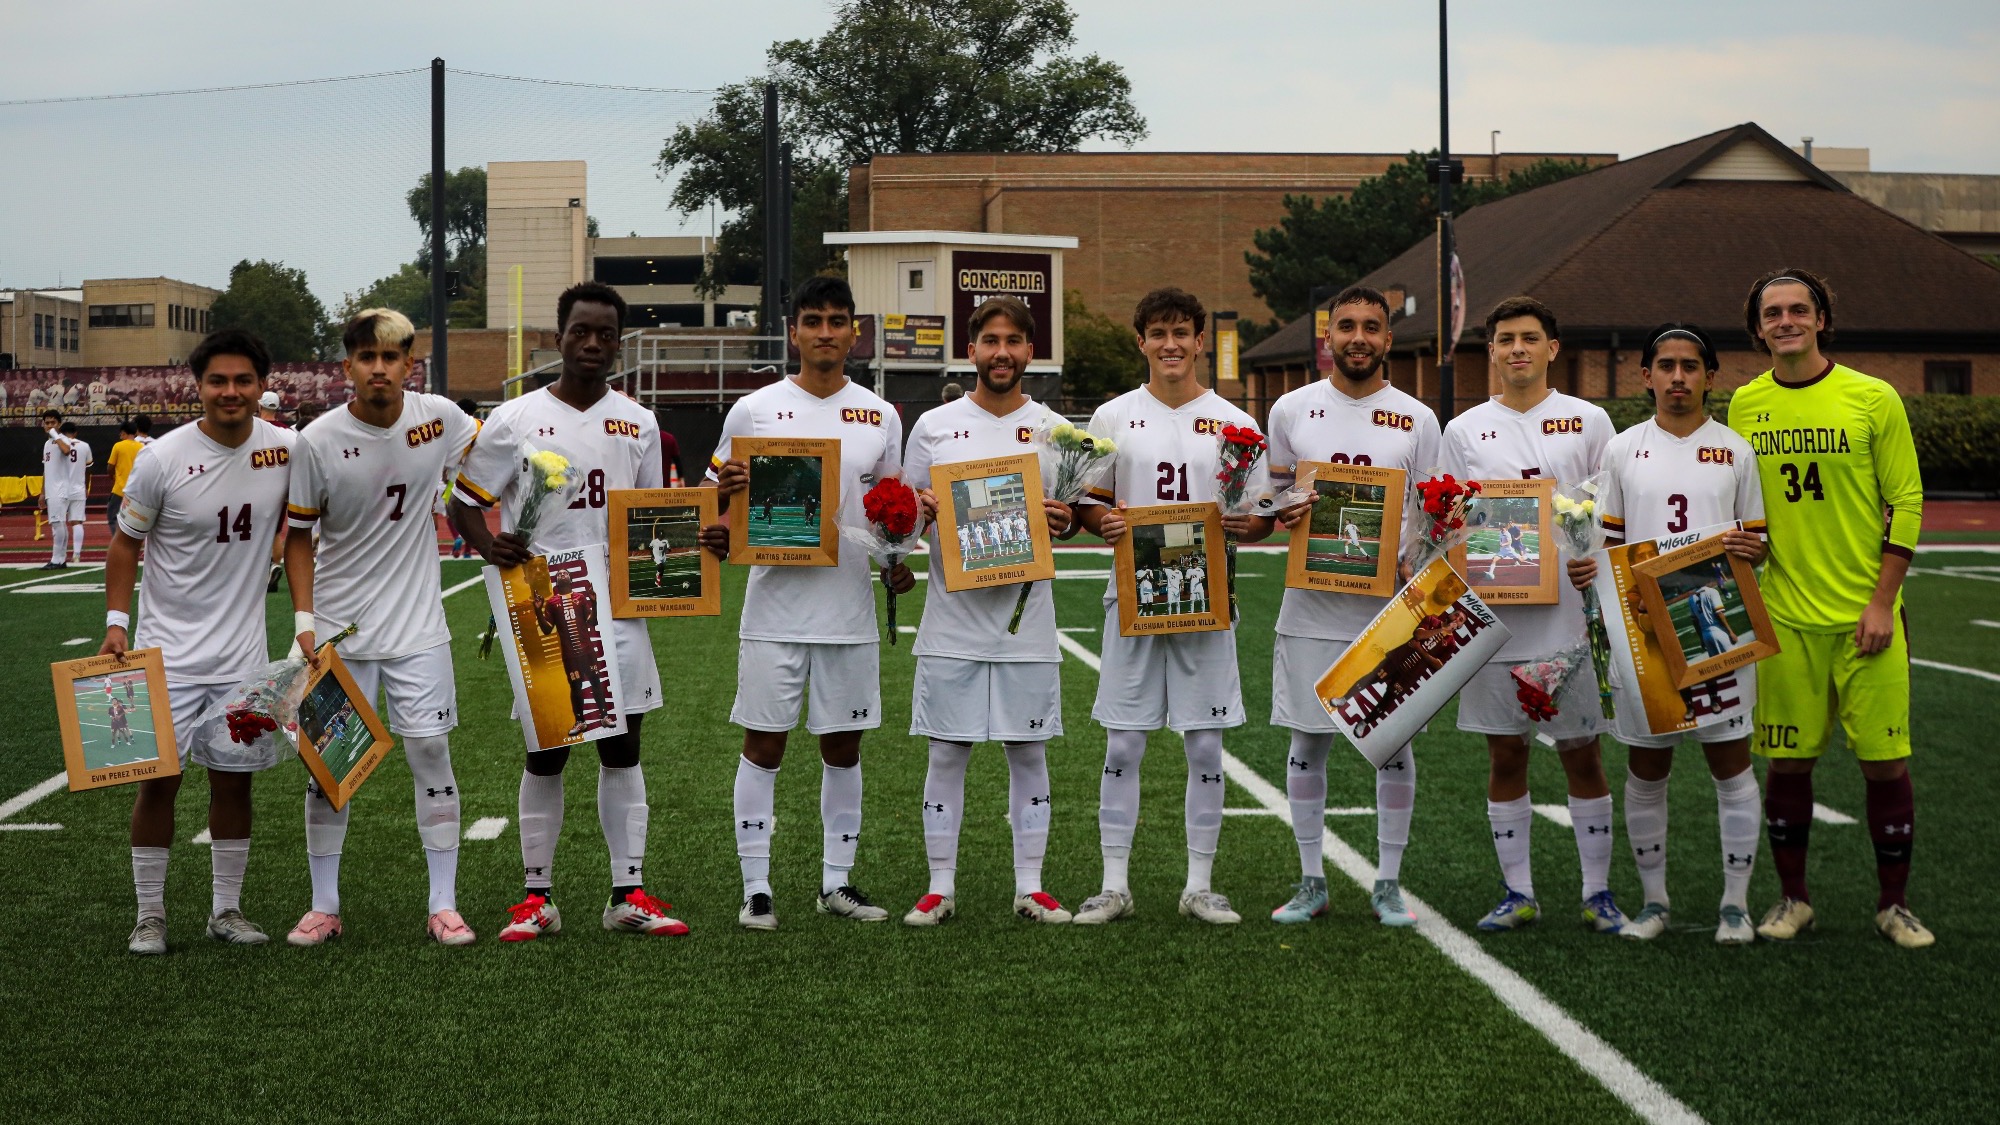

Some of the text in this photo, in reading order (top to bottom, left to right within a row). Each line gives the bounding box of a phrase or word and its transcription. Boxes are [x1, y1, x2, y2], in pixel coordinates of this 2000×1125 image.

[959, 269, 1045, 293] CONCORDIA
[840, 407, 882, 427] CUC
[1193, 417, 1232, 436] CU
[1371, 408, 1414, 432] CUC
[1541, 416, 1583, 436] CUC
[405, 417, 444, 449] CUC
[603, 418, 640, 440] CUC
[1751, 428, 1851, 456] CONCORDIA
[251, 446, 289, 470] CUC
[1157, 462, 1189, 501] 21
[1780, 462, 1824, 503] 34
[387, 484, 406, 521] 7
[1667, 493, 1688, 533] 3
[217, 503, 252, 543] 14
[1658, 532, 1700, 551] MIGUEL
[548, 549, 585, 565] ANDRE
[755, 552, 812, 561] MATIAS ZEGARRA
[975, 570, 1026, 583] JESUS BADILLO
[1308, 576, 1372, 590] MIGUEL SALAMANCA
[636, 603, 695, 612] ANDRE WANGANDU
[1479, 592, 1529, 600] JUAN MORESCO
[564, 608, 576, 620] 28
[1462, 594, 1496, 628] MIGUEL
[1133, 618, 1216, 631] ELISHUAH DELGADO VILLA
[1698, 650, 1755, 676] MIGUEL FIGUEROA
[1759, 724, 1799, 749] CUC
[91, 766, 157, 783] EVIN PEREZ TELLEZ
[348, 753, 378, 789] JUSTIN OCAMPO
